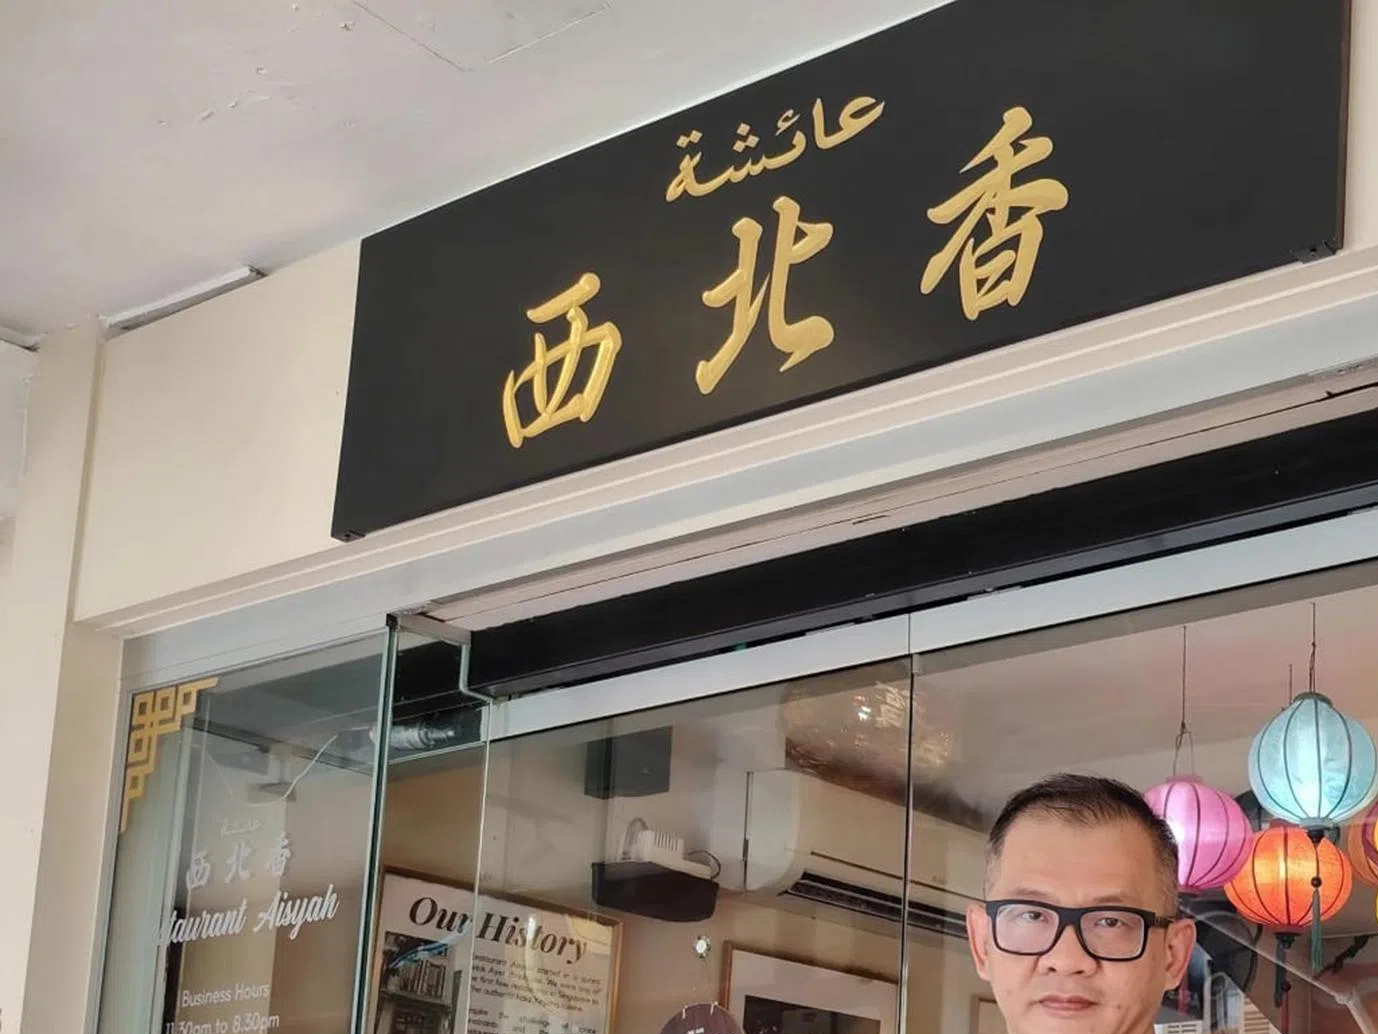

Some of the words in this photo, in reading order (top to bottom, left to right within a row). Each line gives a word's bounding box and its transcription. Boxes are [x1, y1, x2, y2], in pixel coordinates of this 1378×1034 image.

[665, 93, 886, 203] عائشة
[501, 105, 1068, 448] 西北香
[253, 884, 340, 940] Aisyah
[409, 896, 473, 934] Our
[476, 911, 588, 965] History
[182, 987, 231, 1007] Business
[235, 983, 270, 999] Hours
[216, 1018, 228, 1034] to
